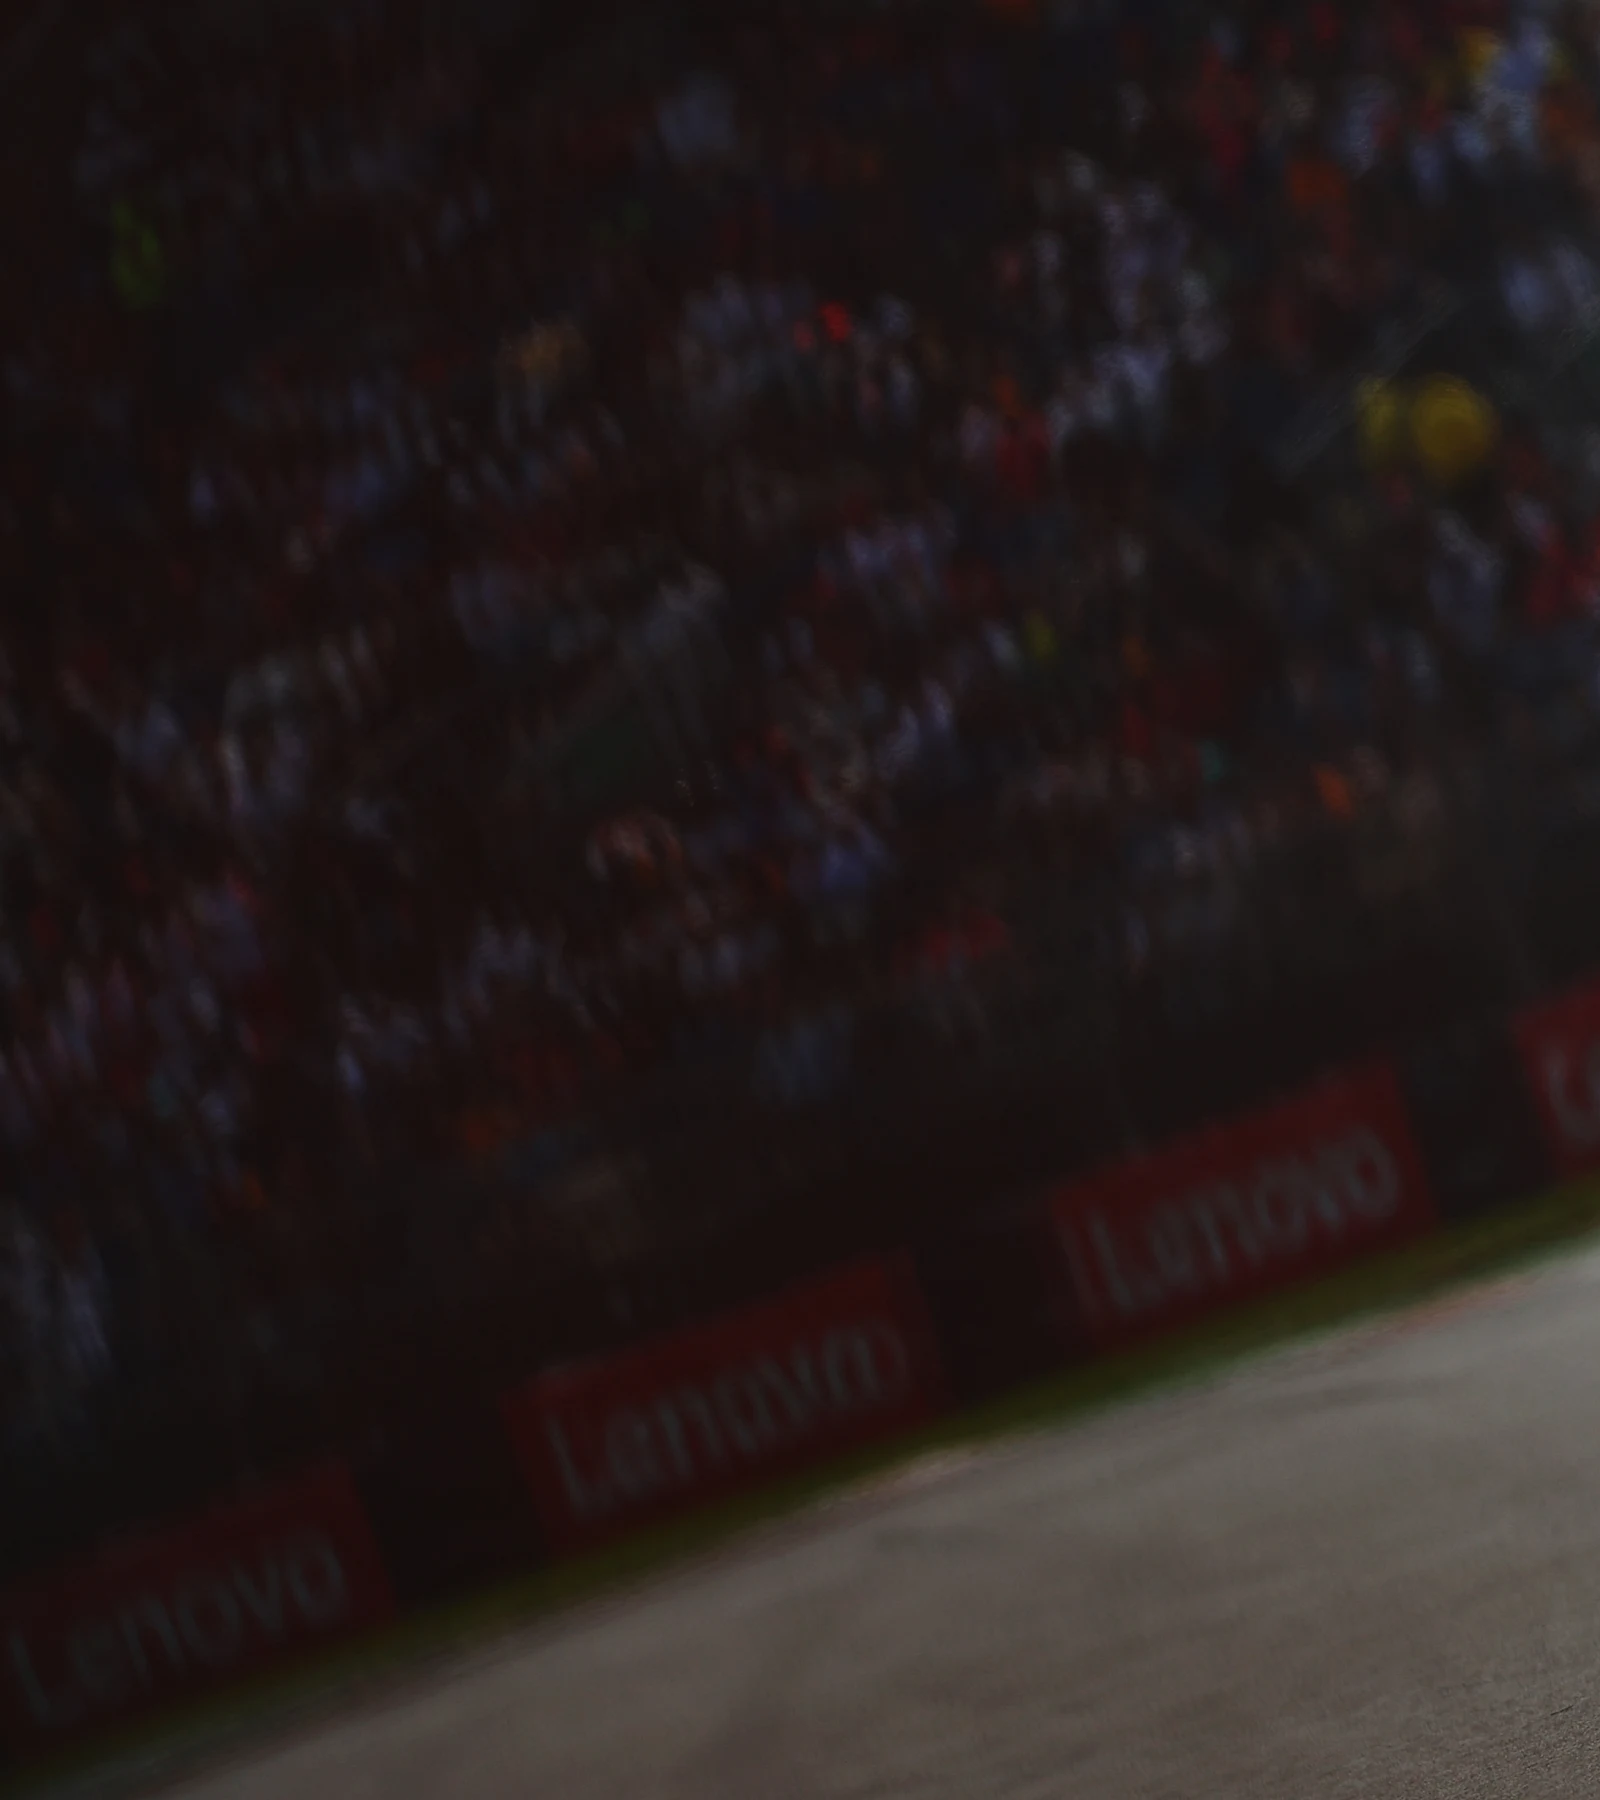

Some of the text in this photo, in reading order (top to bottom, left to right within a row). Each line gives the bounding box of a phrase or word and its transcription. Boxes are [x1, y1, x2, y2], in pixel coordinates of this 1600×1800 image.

[1084, 1126, 1398, 1316] Lenovo
[545, 1322, 908, 1522] Lenovo
[8, 1528, 348, 1726] Lenovo
